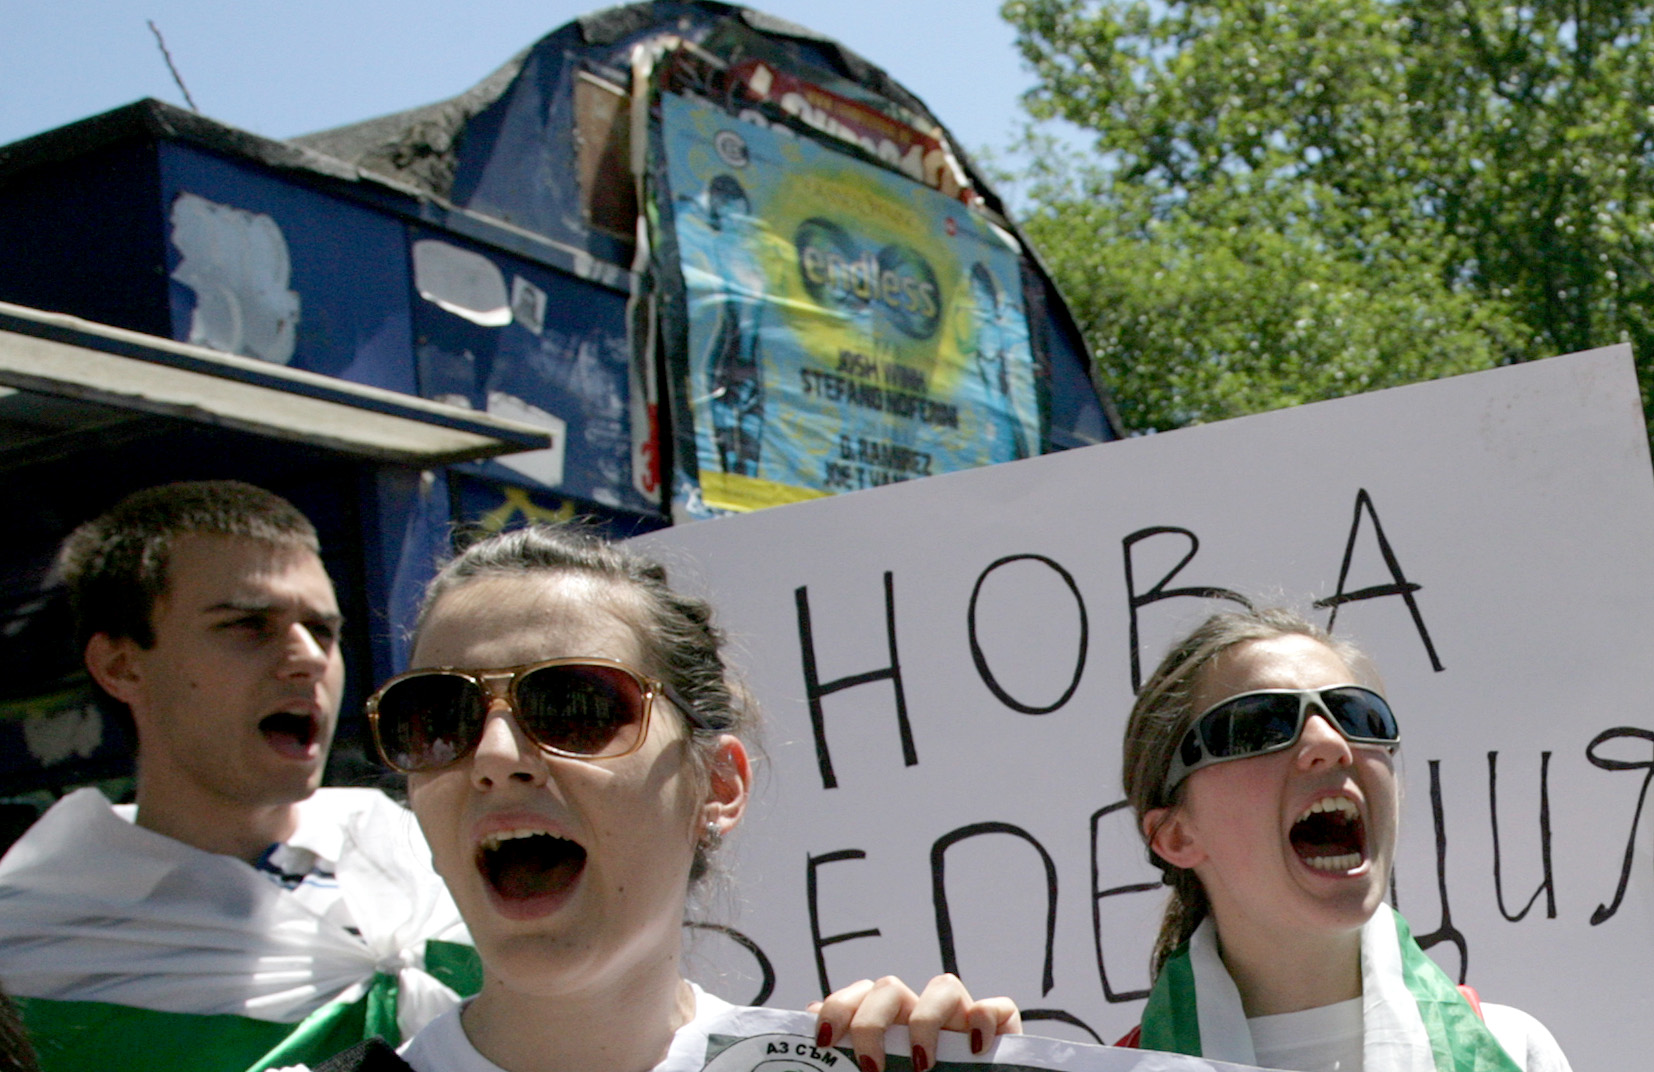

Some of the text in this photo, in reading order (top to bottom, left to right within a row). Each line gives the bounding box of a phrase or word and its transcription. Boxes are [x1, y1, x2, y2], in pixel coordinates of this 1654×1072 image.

[804, 248, 936, 317] endless
[794, 488, 1445, 789] НОВА
[766, 1041, 838, 1068] АЗ СЪМ
